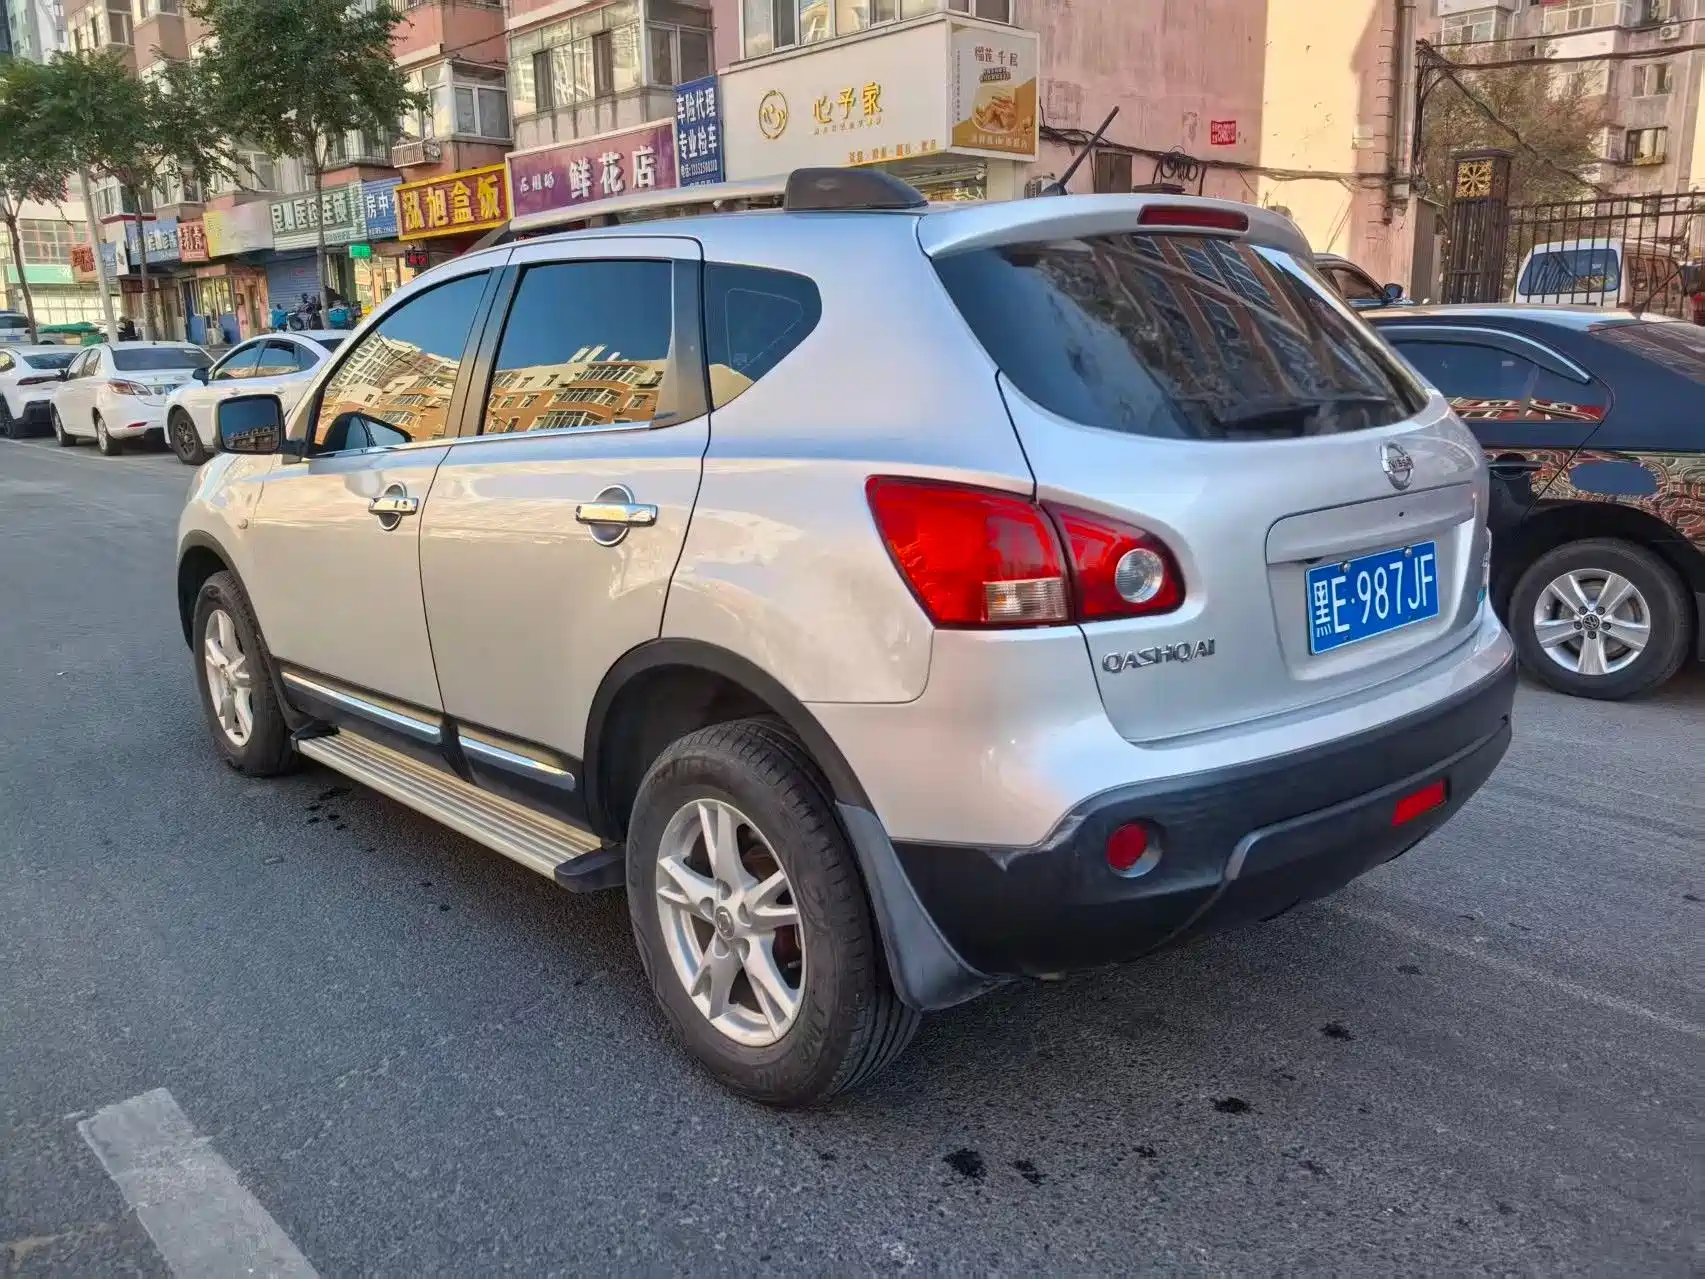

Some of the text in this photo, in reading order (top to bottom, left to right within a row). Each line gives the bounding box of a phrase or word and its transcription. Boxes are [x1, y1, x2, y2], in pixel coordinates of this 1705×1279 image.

[676, 87, 716, 125] 车险代理
[678, 123, 718, 160] 专业检车
[569, 144, 656, 199] 鲜花店
[1101, 638, 1216, 674] QASHQAI
